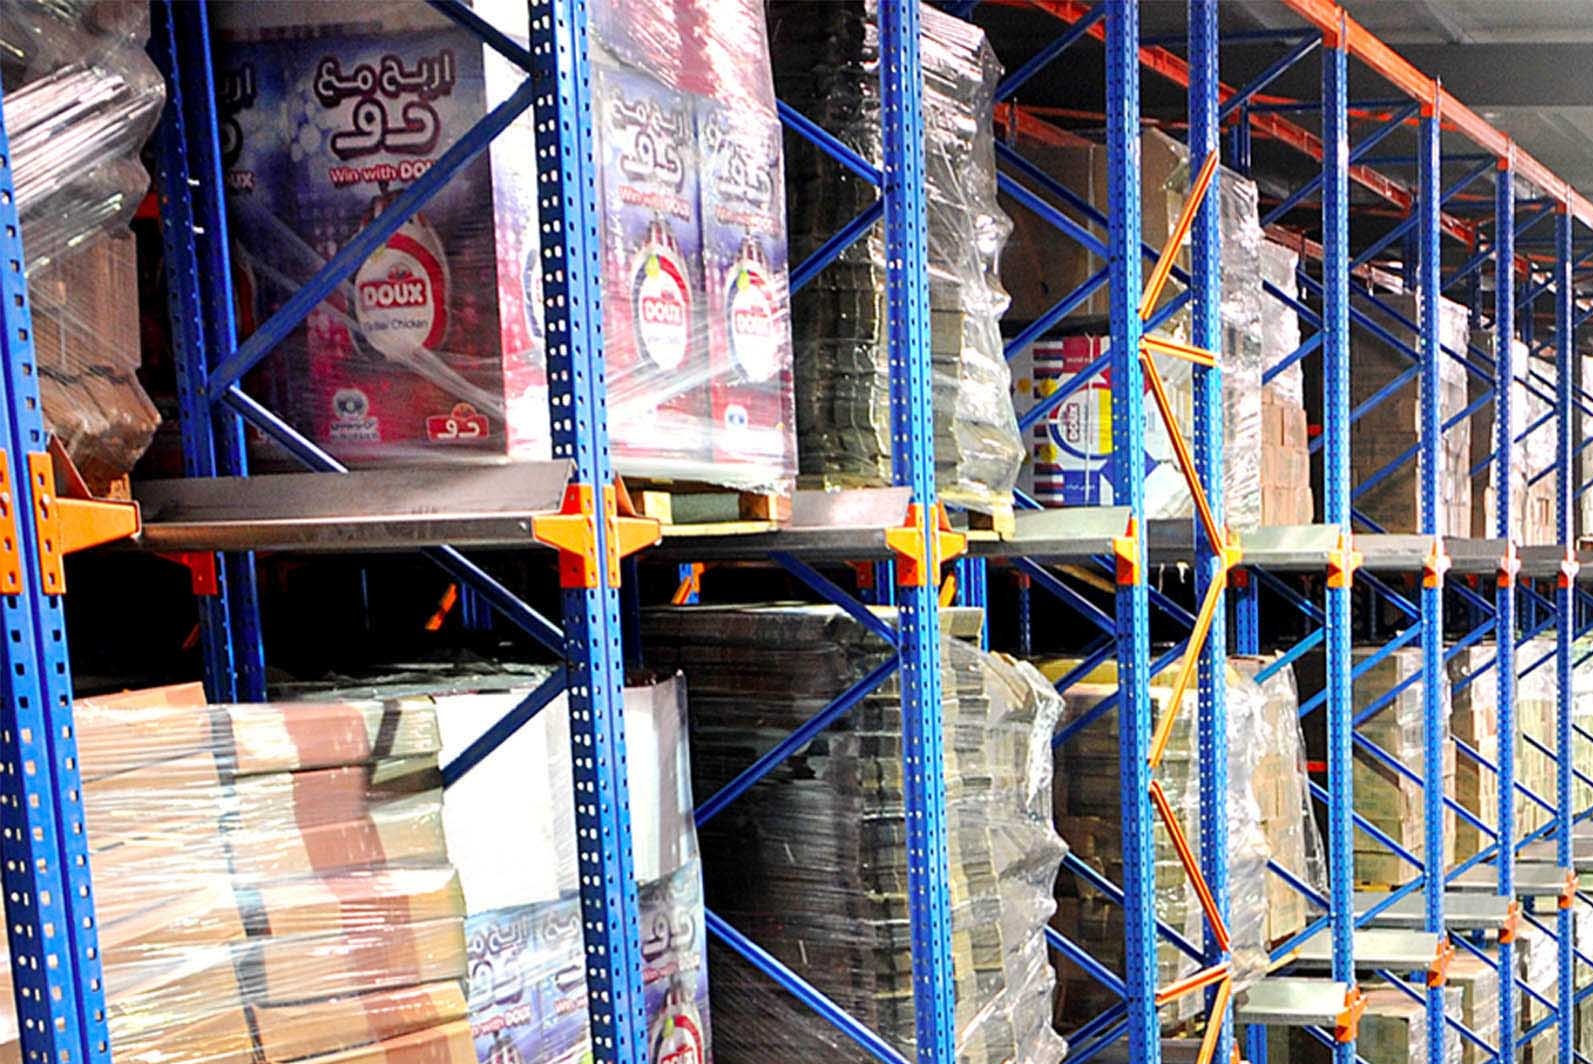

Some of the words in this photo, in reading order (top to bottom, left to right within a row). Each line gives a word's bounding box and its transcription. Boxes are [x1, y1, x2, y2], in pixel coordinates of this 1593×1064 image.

[330, 165, 360, 186] Win
[362, 163, 398, 183] with
[400, 159, 436, 180] DO
[362, 282, 425, 307] DOUX
[643, 299, 683, 325] DOUX
